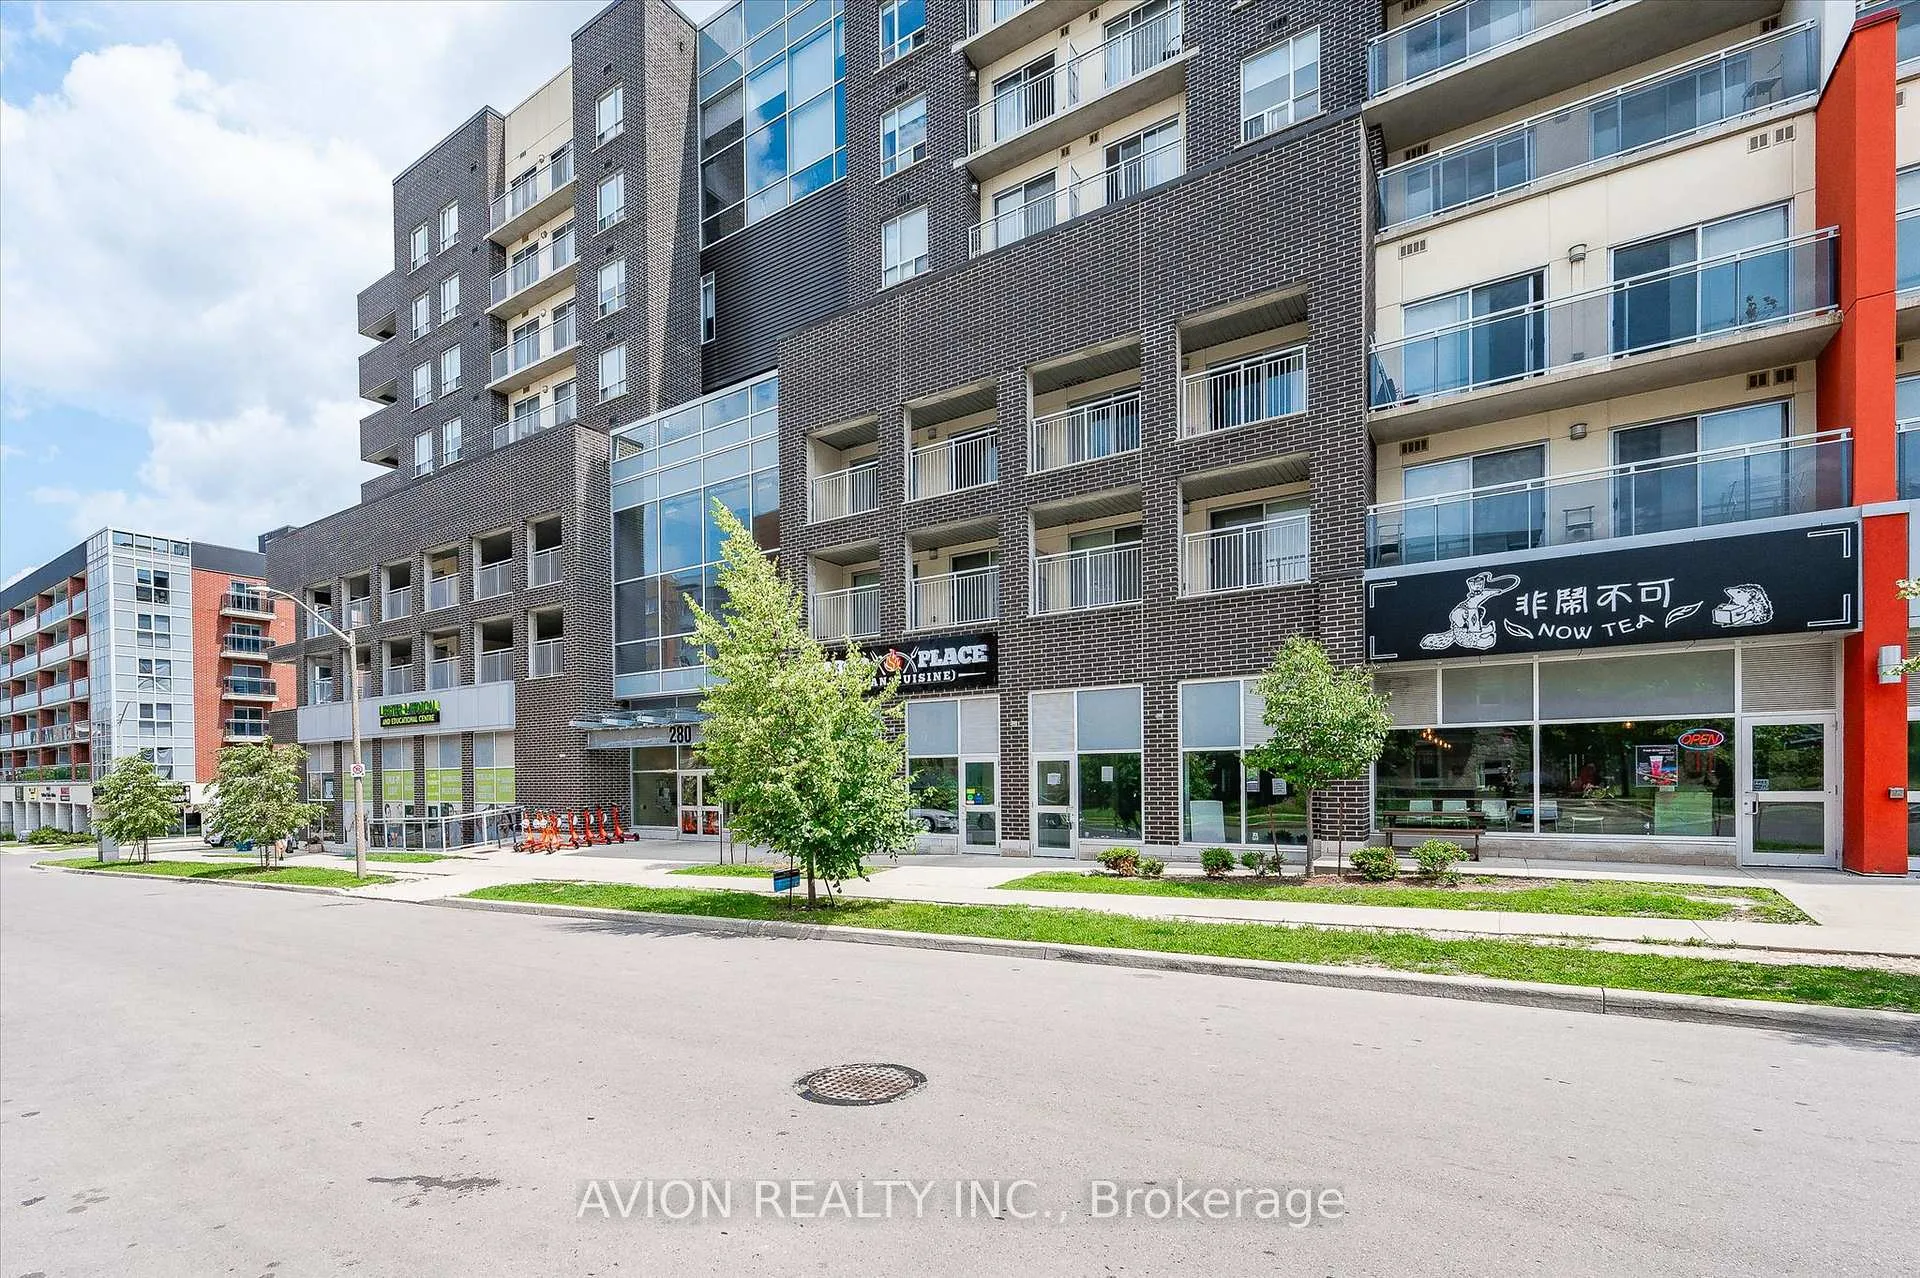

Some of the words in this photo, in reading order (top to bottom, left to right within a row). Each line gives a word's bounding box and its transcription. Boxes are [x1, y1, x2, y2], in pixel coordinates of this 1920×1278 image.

[1515, 578, 1675, 619] 非鬧不可
[1538, 623, 1592, 640] NOW
[1601, 614, 1655, 637] TEA
[917, 644, 988, 668] PLACE
[894, 669, 957, 687] UISINE)
[669, 725, 692, 743] 280
[1680, 733, 1720, 745] OPEN
